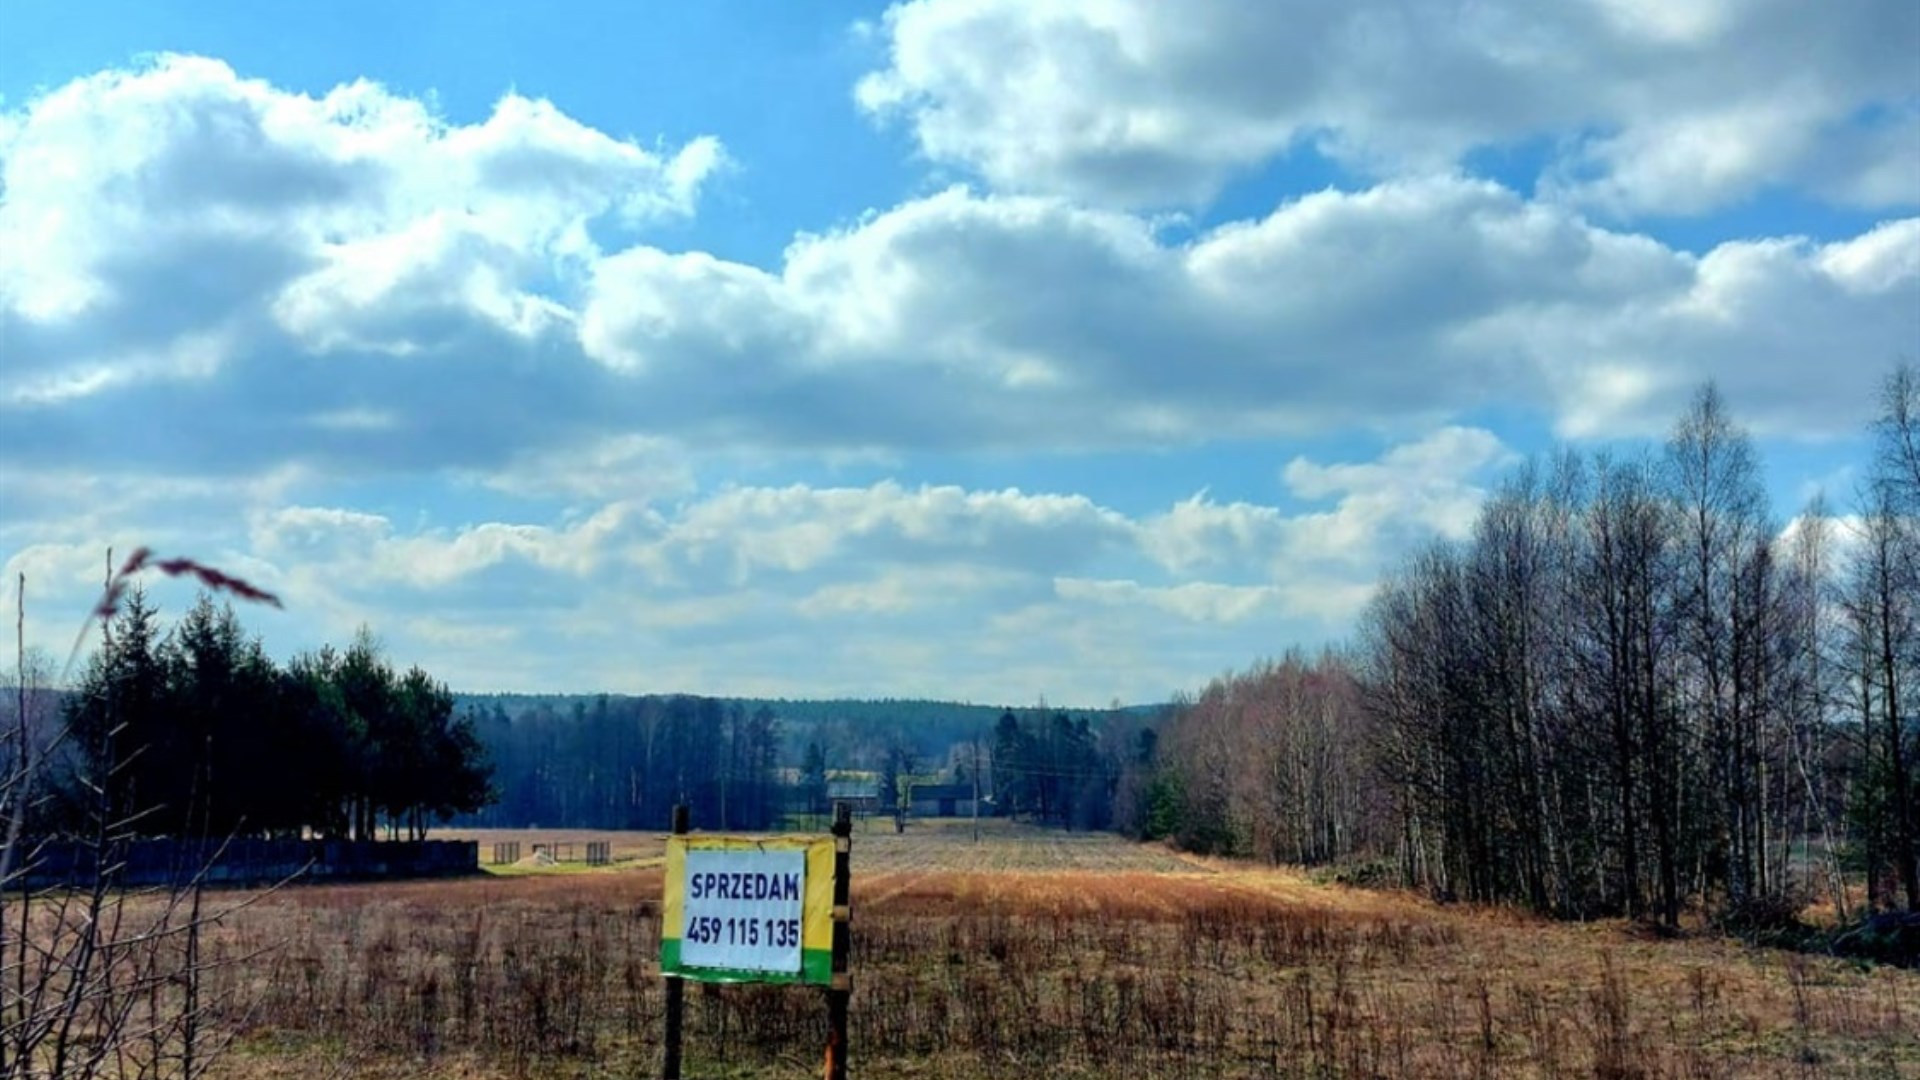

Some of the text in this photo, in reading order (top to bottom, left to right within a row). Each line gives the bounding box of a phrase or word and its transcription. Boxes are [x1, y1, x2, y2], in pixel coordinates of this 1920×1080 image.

[691, 873, 799, 901] SPRZEDAM
[687, 916, 799, 947] 459 115 135
